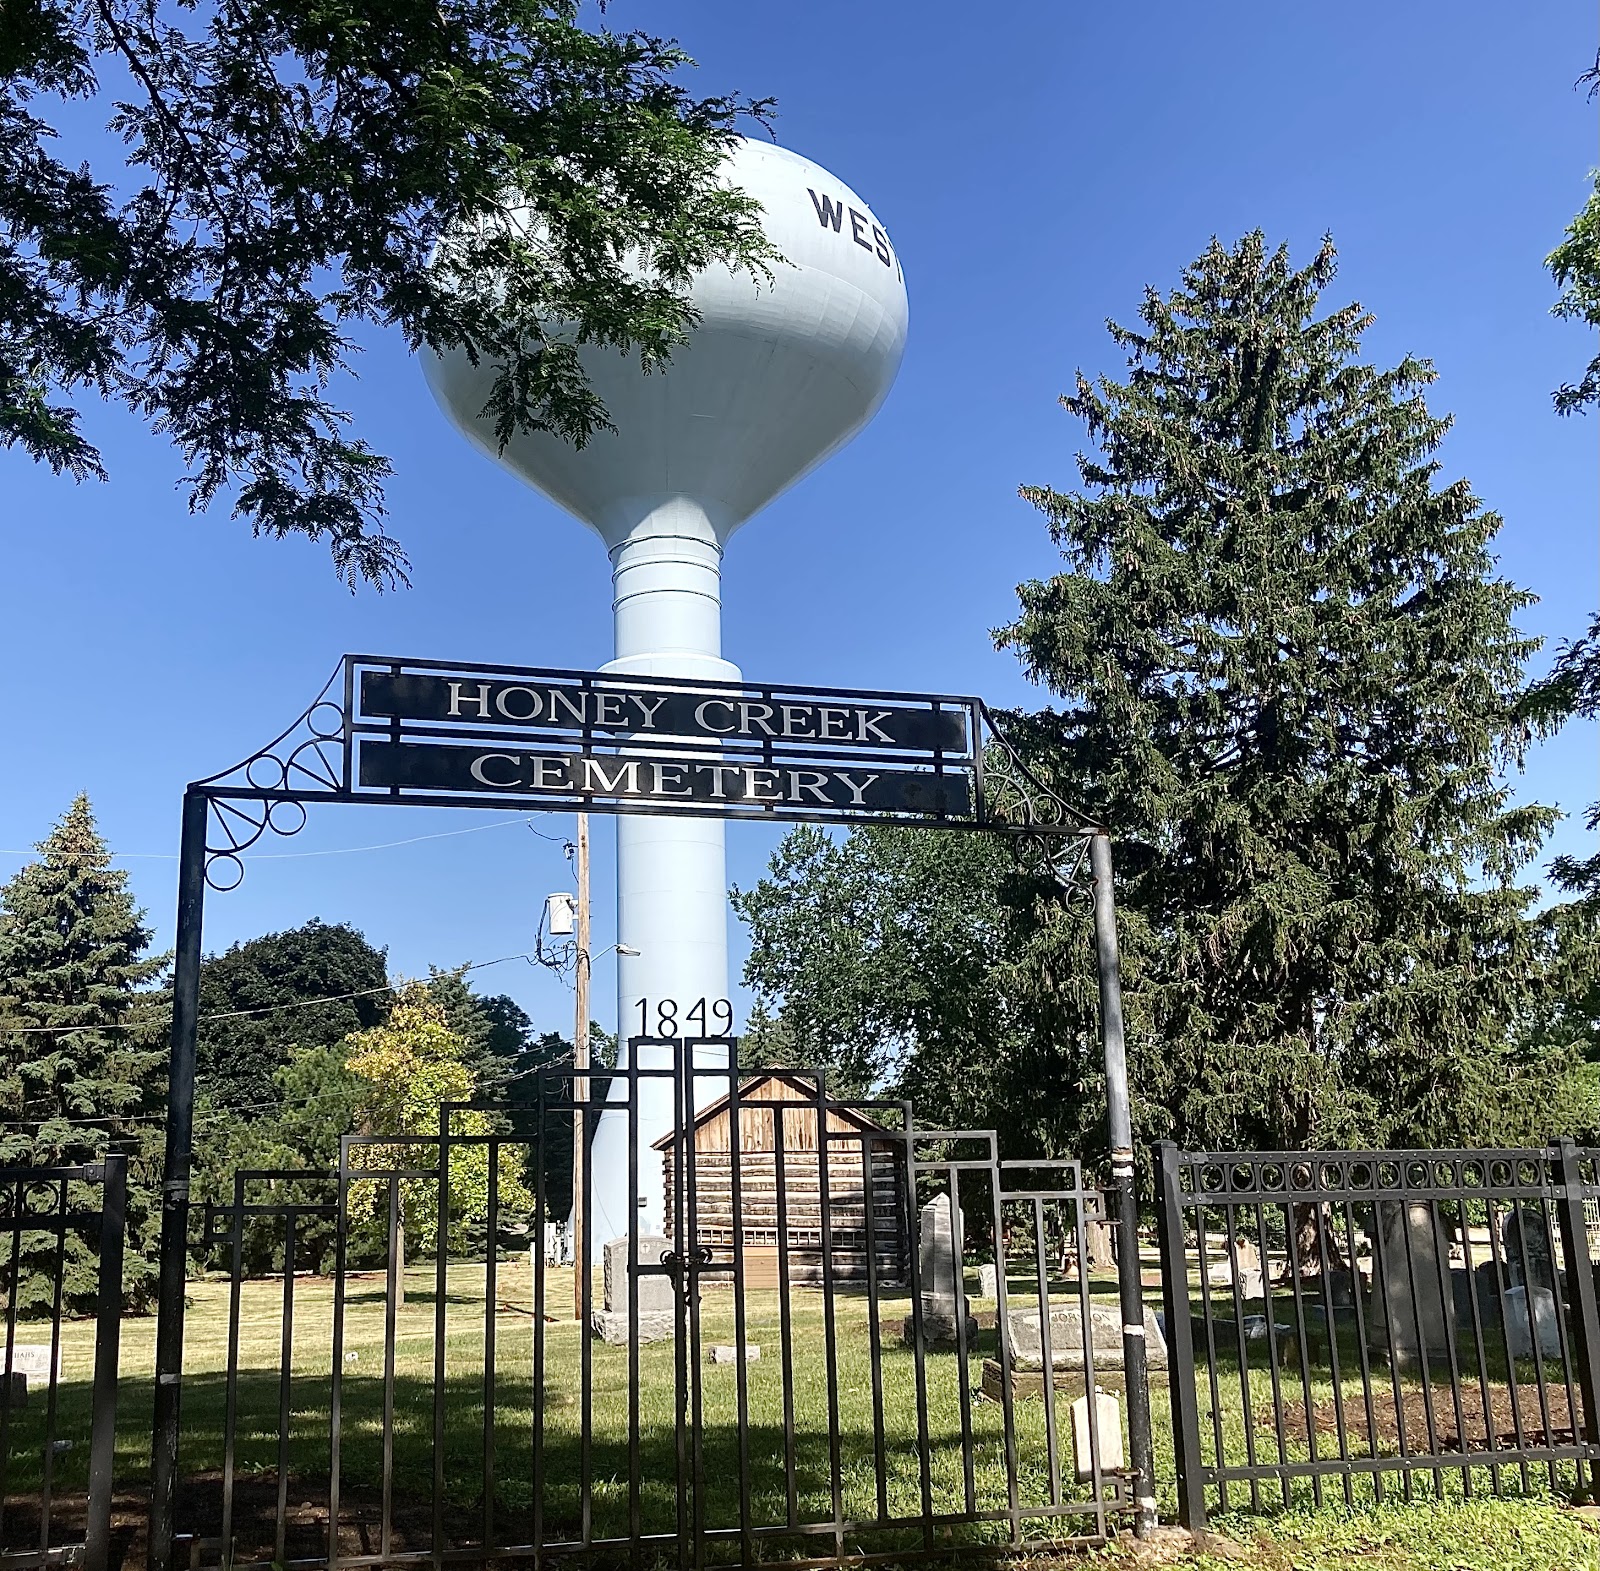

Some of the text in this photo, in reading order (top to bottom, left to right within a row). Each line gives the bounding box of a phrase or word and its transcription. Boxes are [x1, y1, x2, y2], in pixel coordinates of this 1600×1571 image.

[447, 682, 896, 744] HONEY CREEK
[470, 753, 879, 805] CEMETERY
[634, 997, 733, 1038] 1849
